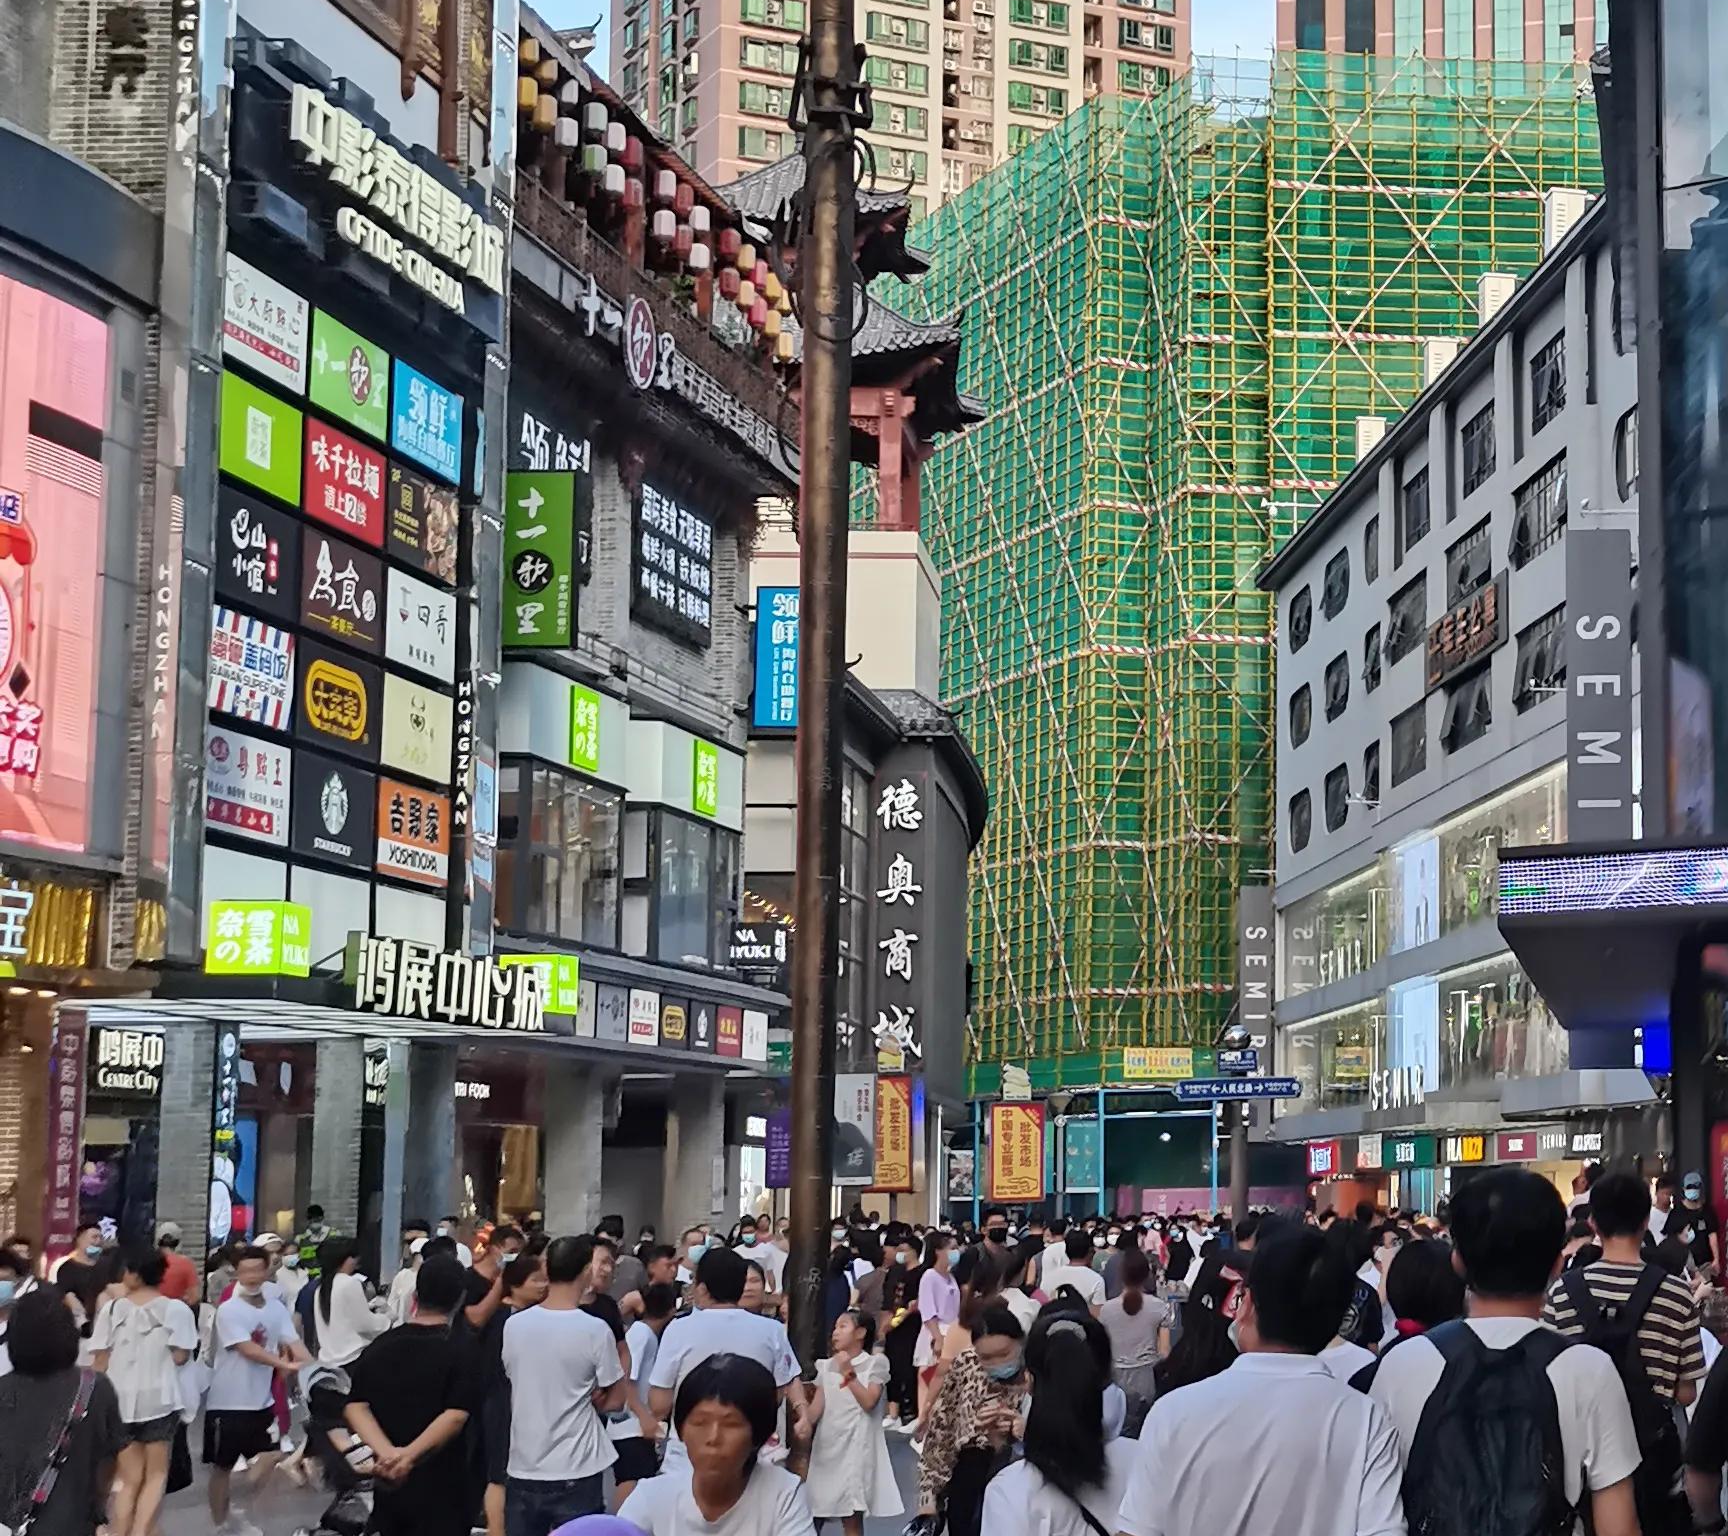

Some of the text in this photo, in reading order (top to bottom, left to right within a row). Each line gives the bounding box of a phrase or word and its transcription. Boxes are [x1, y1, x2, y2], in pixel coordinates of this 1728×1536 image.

[289, 83, 504, 296] 中影泰得影城
[400, 250, 465, 314] CINEMA
[455, 681, 472, 825] HONGZHAN
[1575, 614, 1622, 808] SEMI
[215, 909, 276, 939] 奈雪
[215, 939, 274, 965] の茶
[872, 779, 923, 1058] 德奥商城
[356, 936, 546, 1032] 鸿展中心城
[1371, 1064, 1425, 1111] SEMIR
